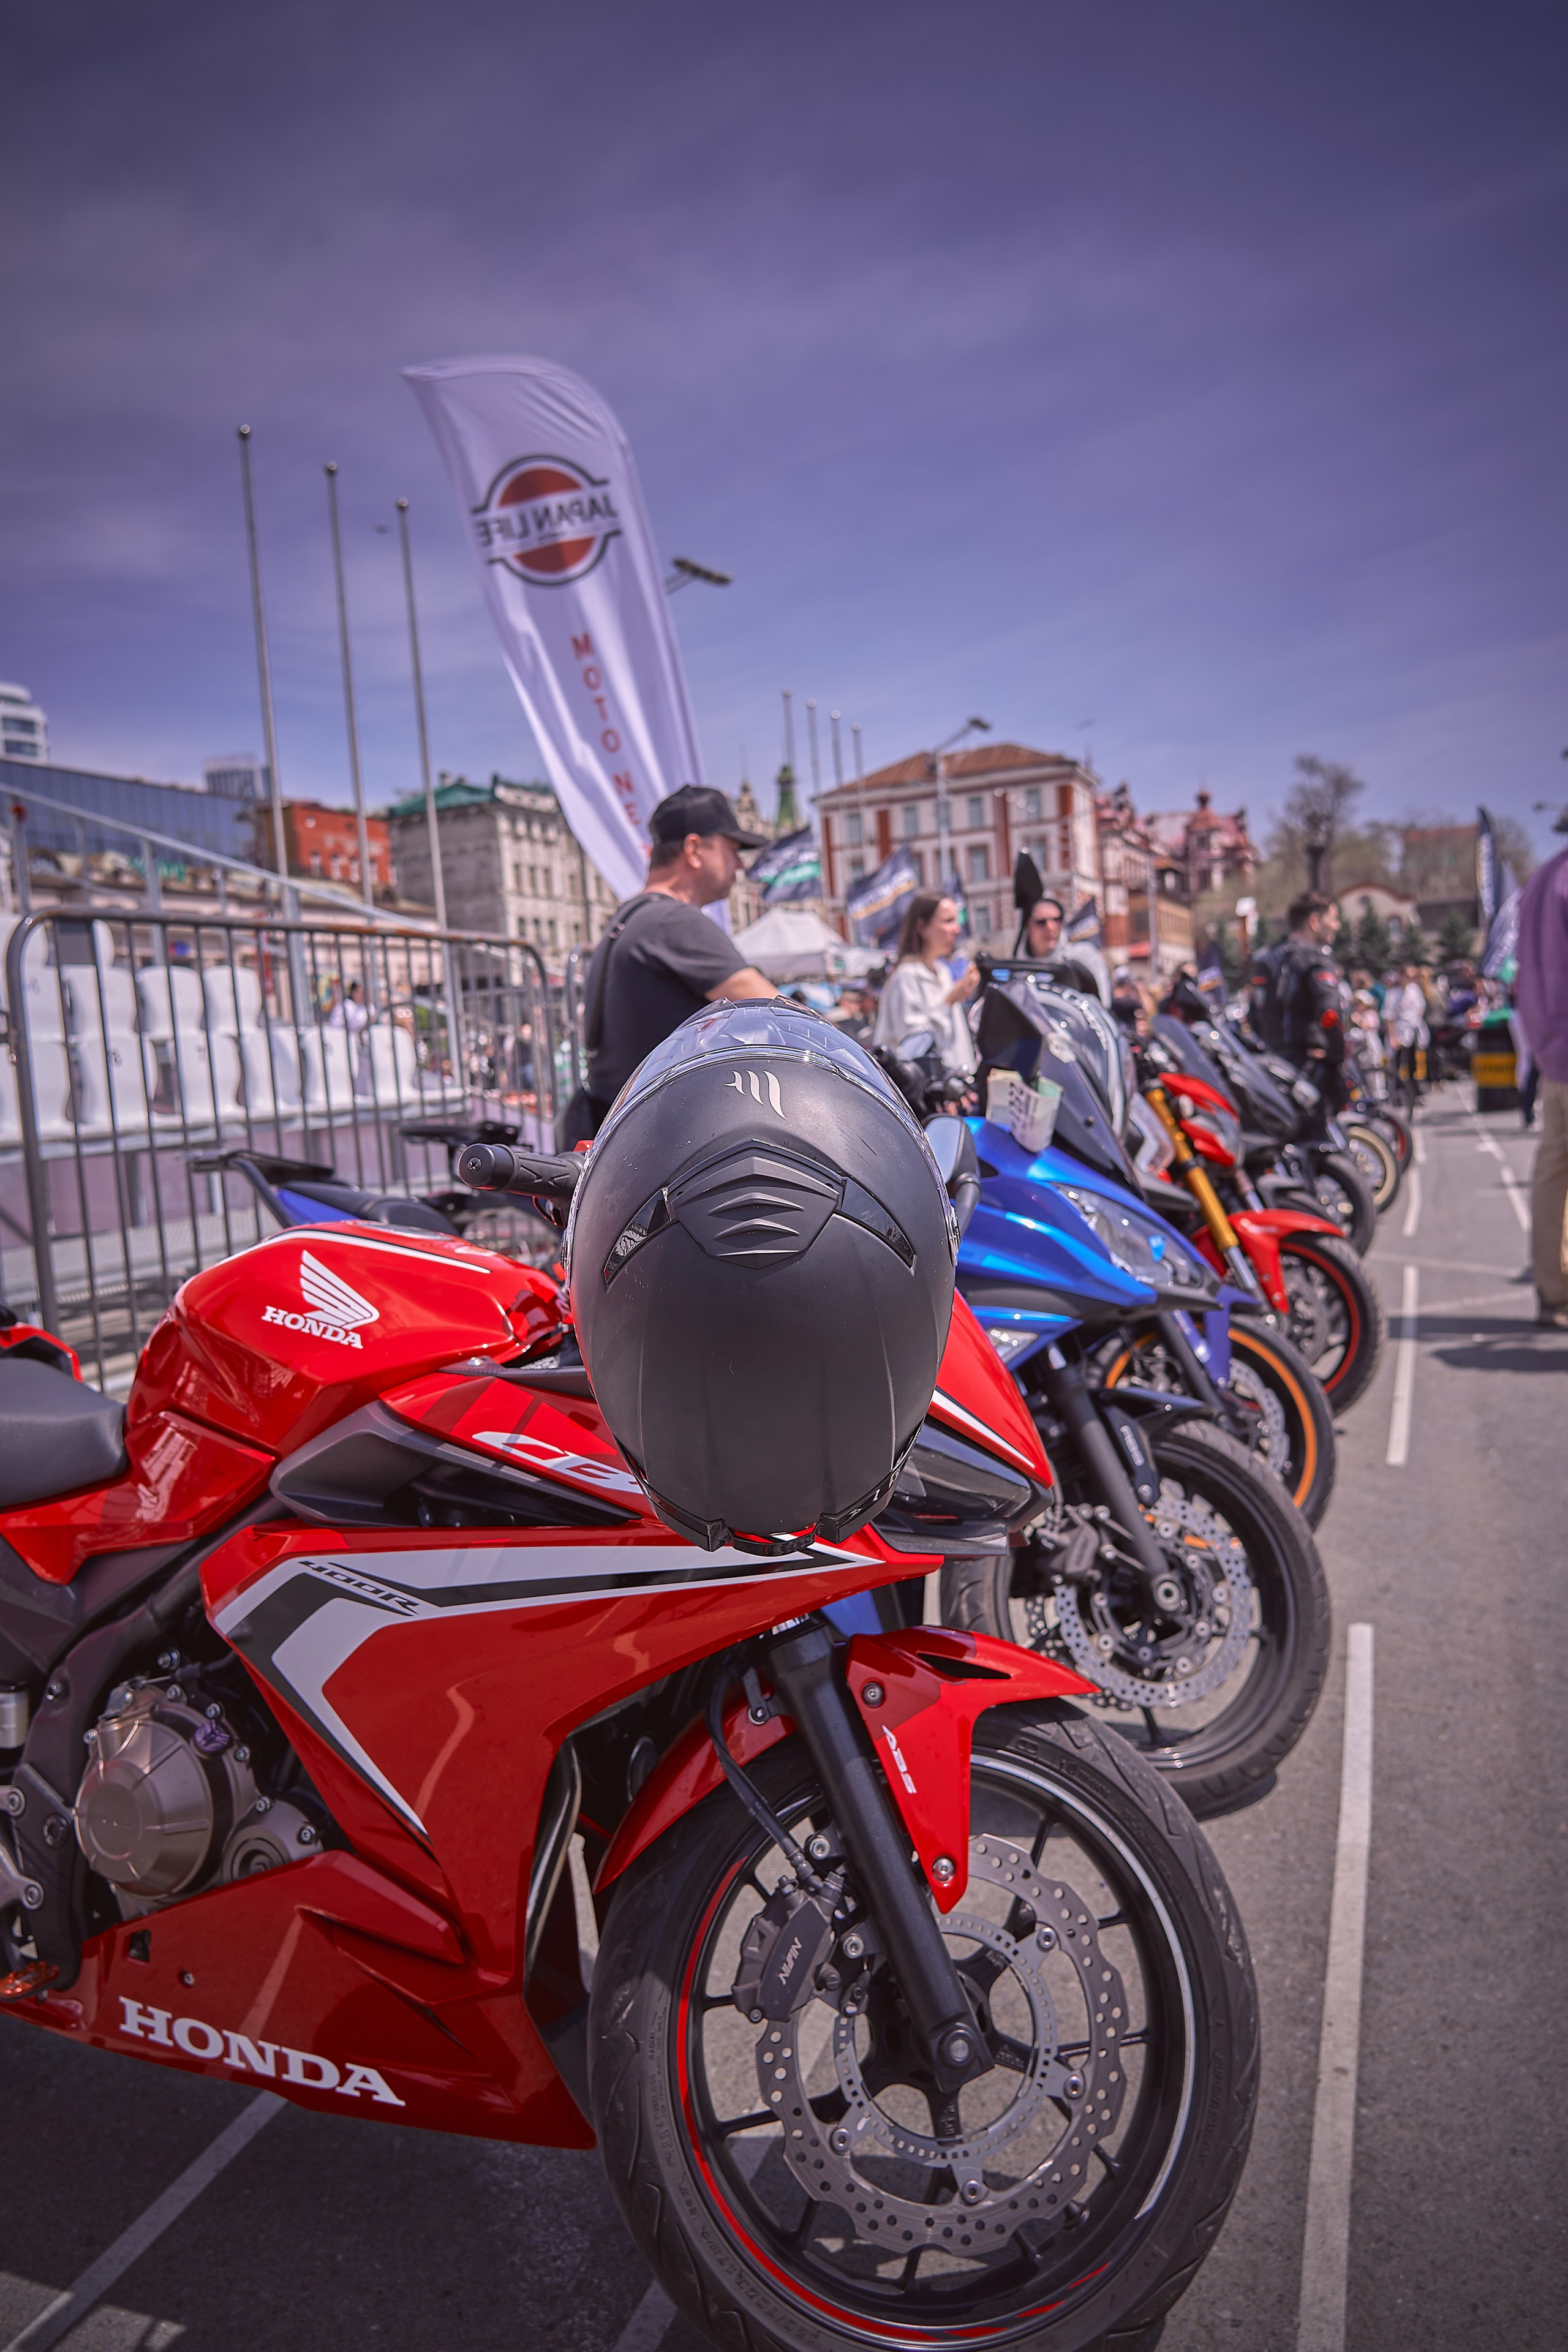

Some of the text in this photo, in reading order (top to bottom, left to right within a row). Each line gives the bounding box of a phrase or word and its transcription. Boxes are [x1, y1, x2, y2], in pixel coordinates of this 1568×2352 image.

[570, 631, 622, 753] MOTO
[261, 1305, 364, 1349] HONDA
[881, 1724, 918, 1794] ABS
[119, 1996, 406, 2107] HONDA
